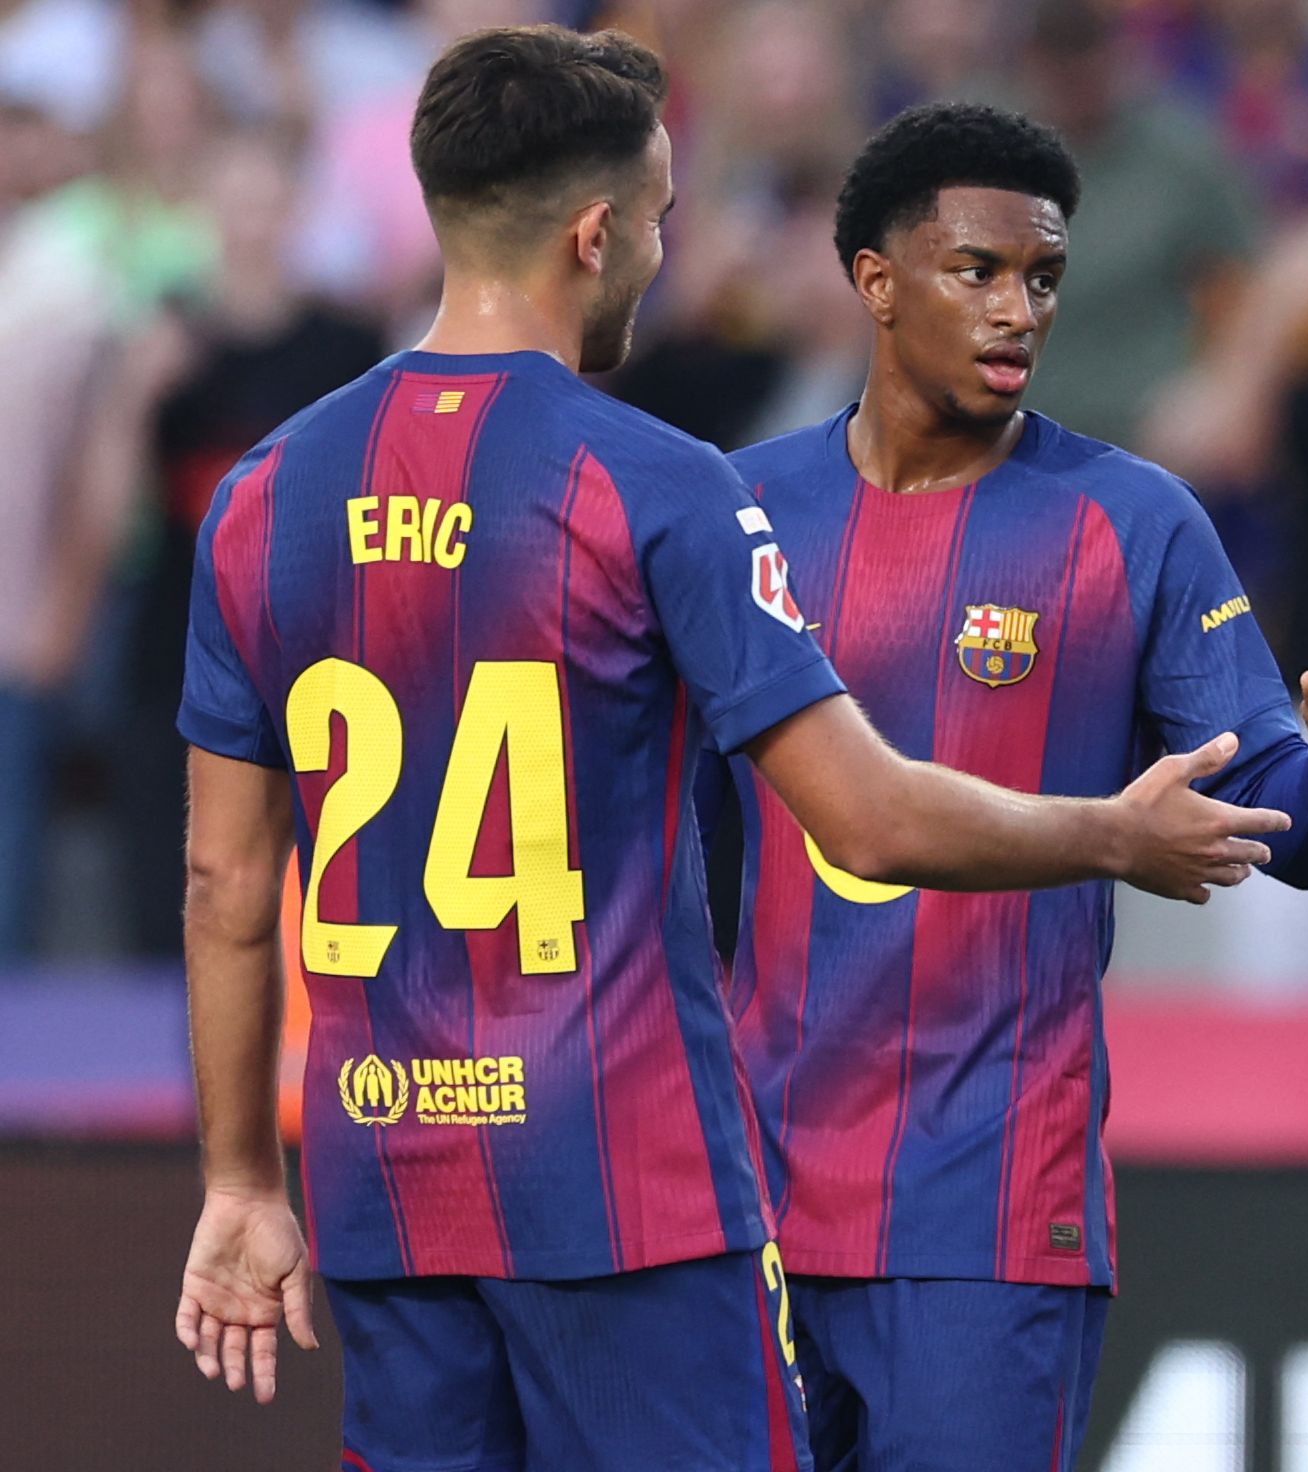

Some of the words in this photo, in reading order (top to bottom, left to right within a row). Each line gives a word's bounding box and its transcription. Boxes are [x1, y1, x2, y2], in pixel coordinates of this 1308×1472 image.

[346, 495, 474, 570] ERIC
[285, 656, 586, 979] 24
[411, 1056, 525, 1086] UNHCR
[415, 1084, 526, 1113] ACNUR
[417, 1113, 436, 1125] The
[436, 1113, 451, 1125] UN
[451, 1113, 488, 1127] Refugee
[488, 1113, 527, 1127] Agency
